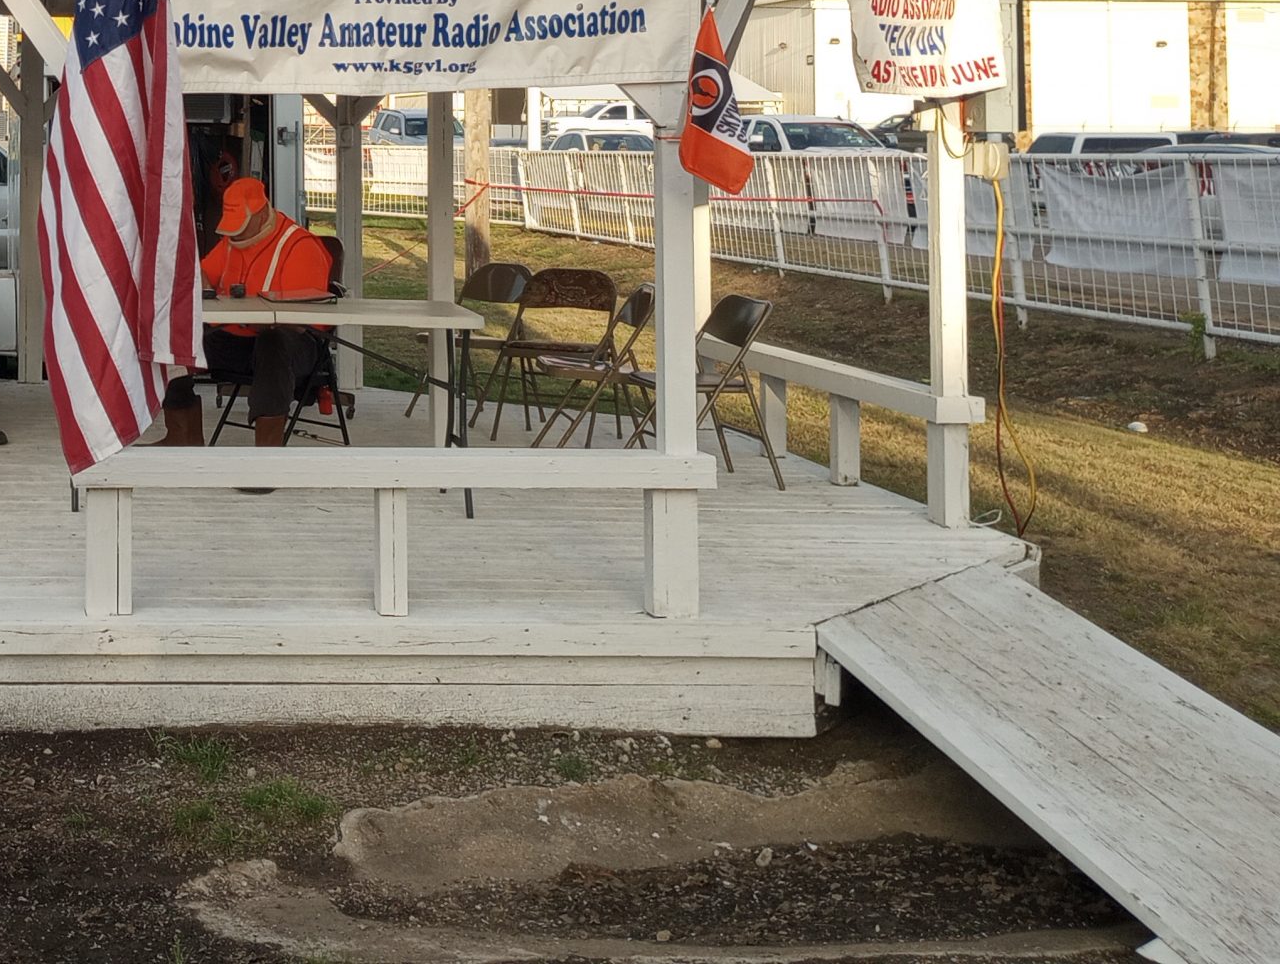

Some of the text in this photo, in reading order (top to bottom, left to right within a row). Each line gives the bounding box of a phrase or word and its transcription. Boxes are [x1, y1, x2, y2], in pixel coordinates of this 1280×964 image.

[173, 1, 647, 56] bine Valley Amateur Radio Association
[332, 57, 478, 76] www.k5gvl.org
[950, 56, 1000, 86] JUNE
